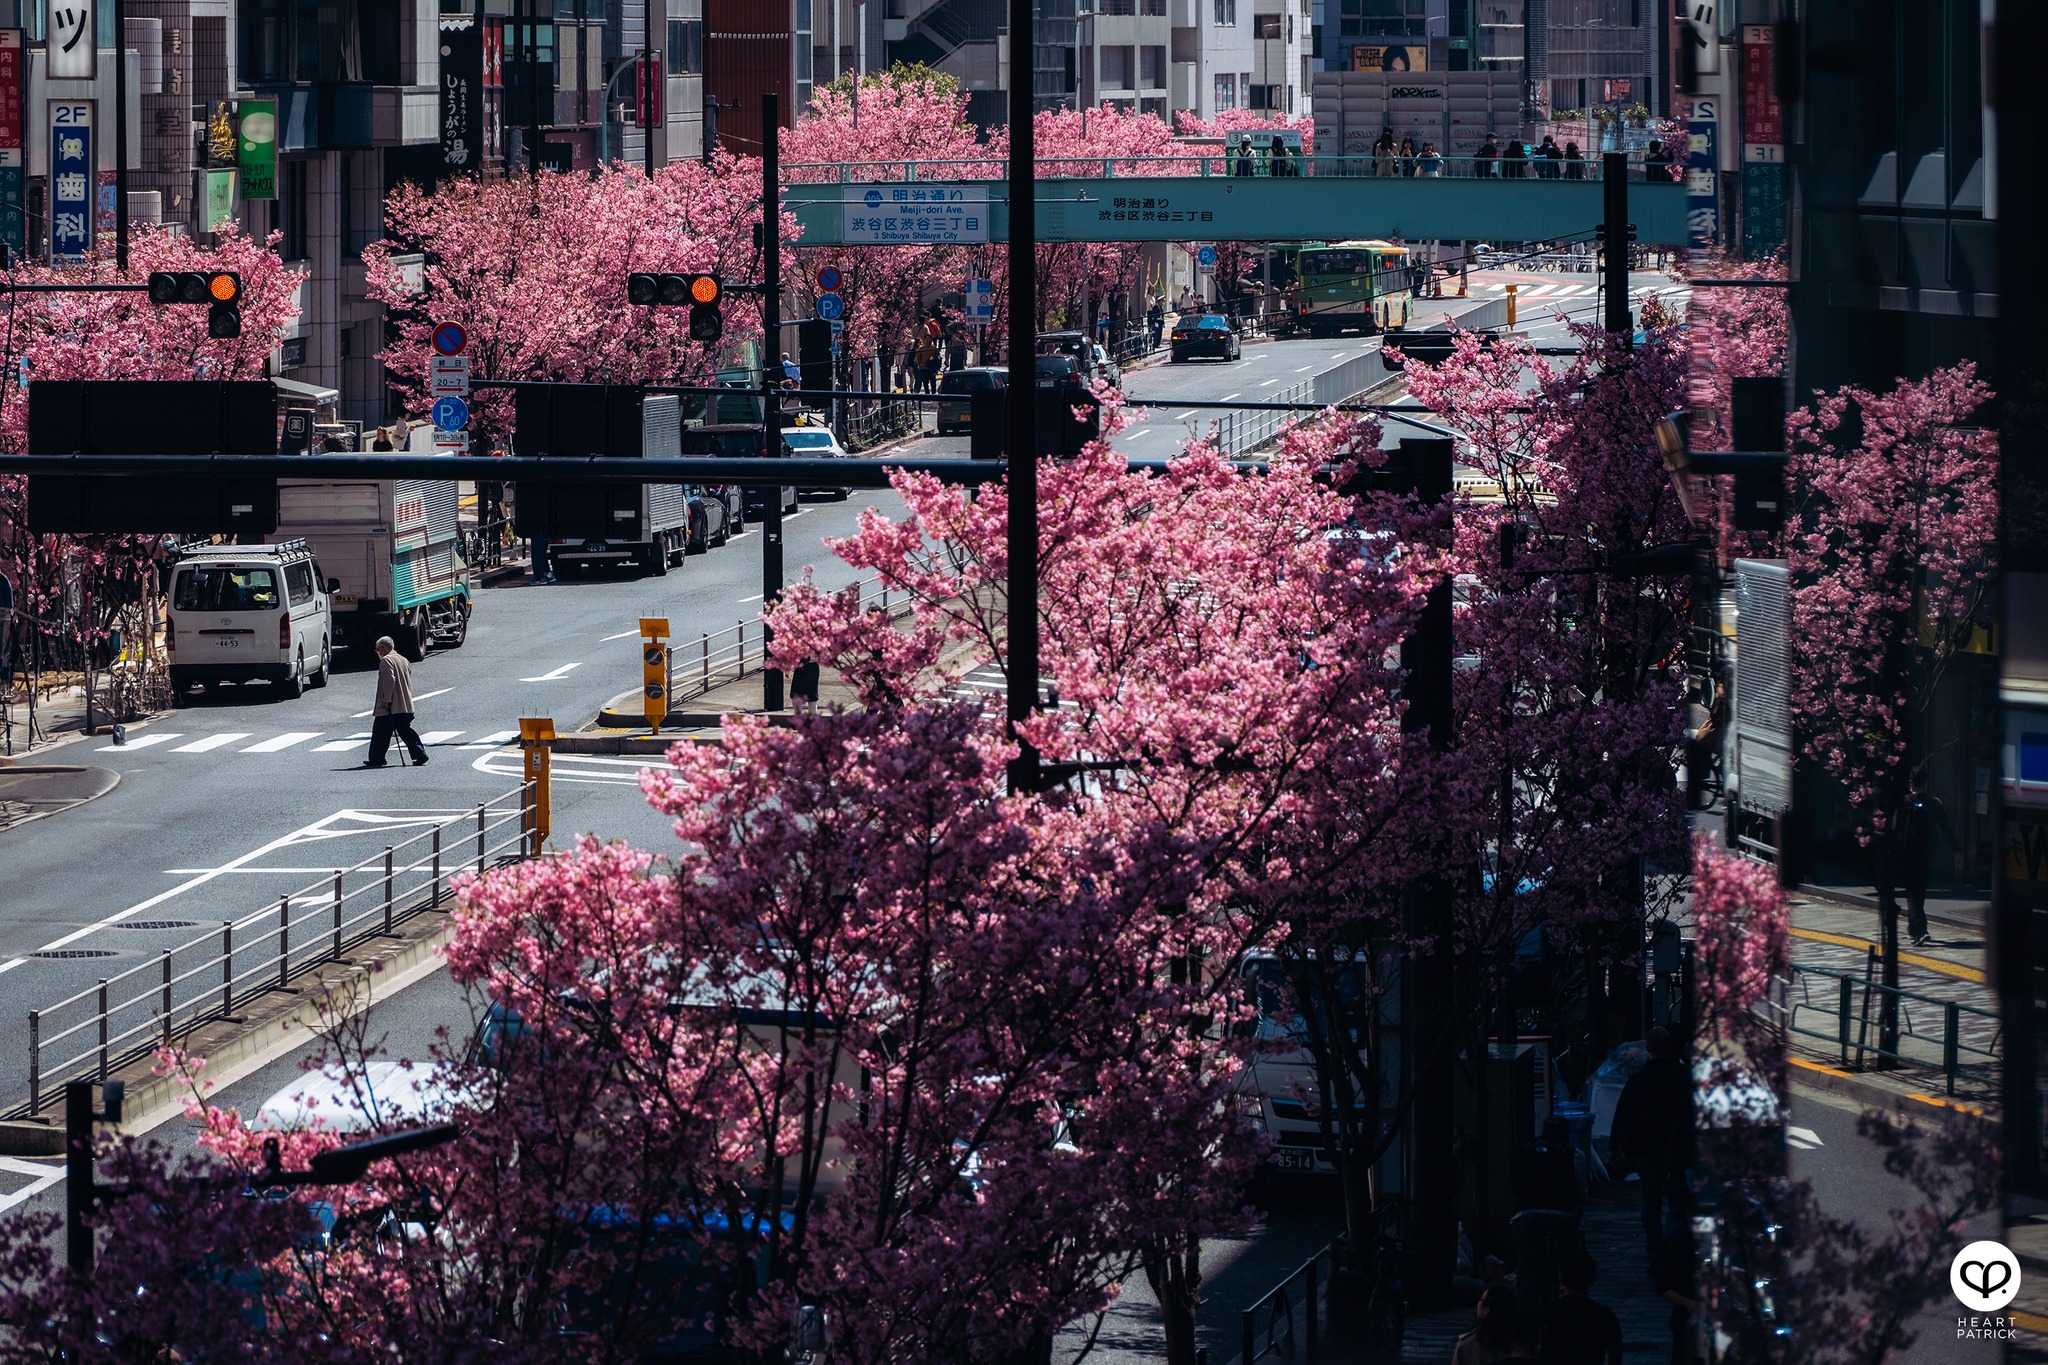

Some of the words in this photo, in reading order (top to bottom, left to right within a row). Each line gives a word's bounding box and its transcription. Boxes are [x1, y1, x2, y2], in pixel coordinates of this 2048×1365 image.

[56, 106, 87, 123] 2F
[444, 74, 469, 165] しょうがの湯
[893, 190, 964, 202] 明治通り
[1113, 197, 1170, 209] 明治通り
[56, 171, 87, 243] 歯科
[900, 205, 943, 216] Meiji-dori
[946, 206, 965, 214] Ave.
[1098, 210, 1213, 222] 渋谷区渋谷三丁目
[852, 217, 979, 231] 渋谷区渋谷三丁目
[873, 232, 879, 240] 3
[881, 232, 910, 240] Shibuya
[912, 232, 941, 240] Shibuya
[943, 232, 958, 240] City
[822, 301, 833, 317] P
[440, 404, 454, 426] P
[449, 416, 460, 426] 60
[1278, 1155, 1310, 1169] 85-14
